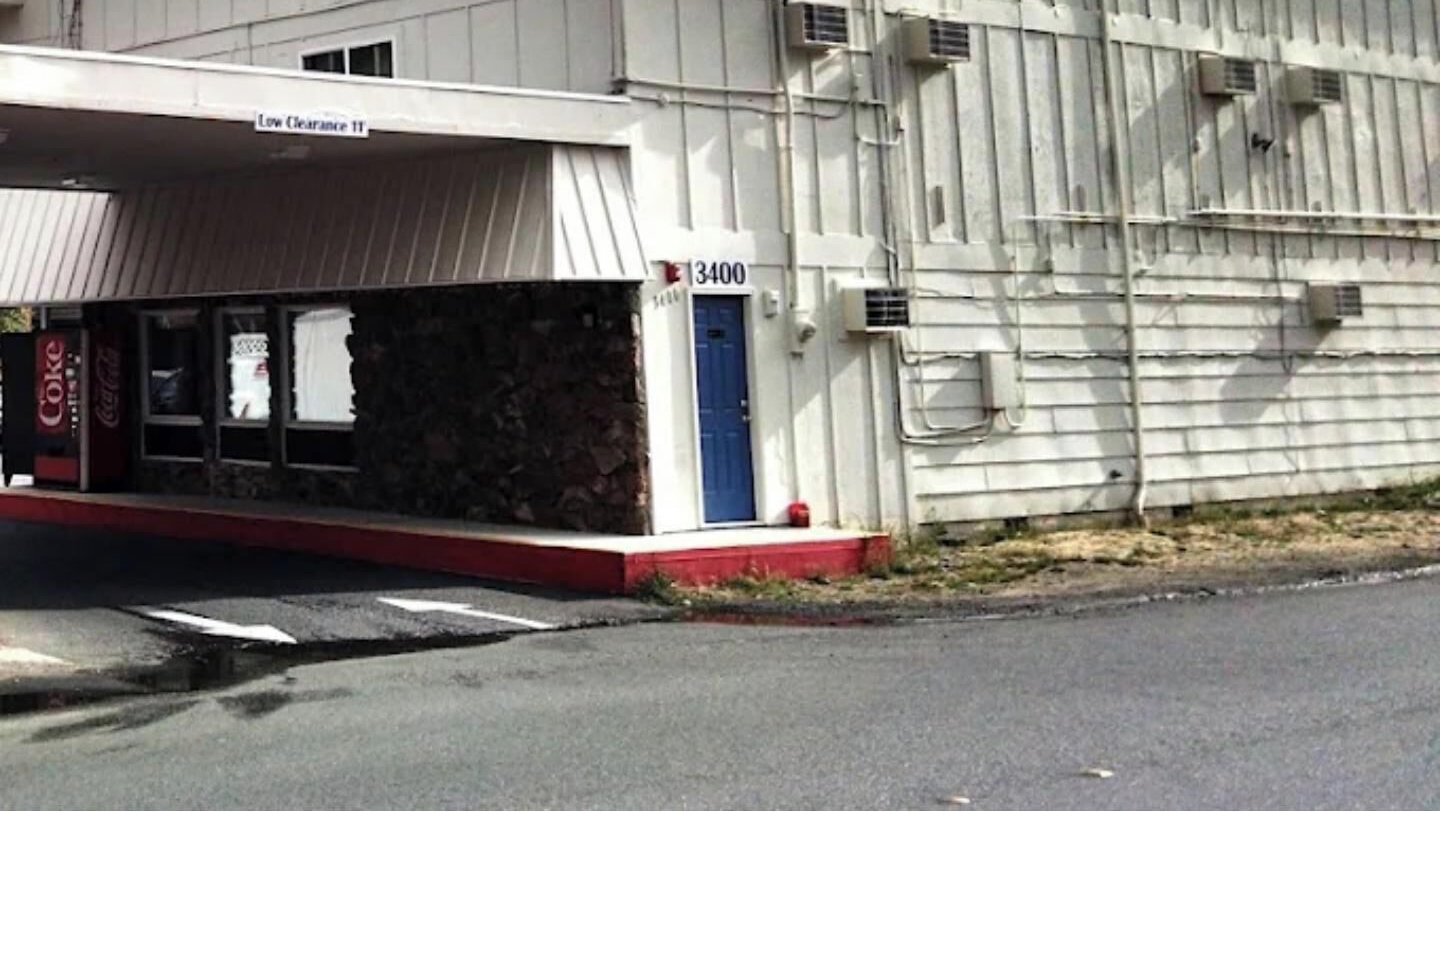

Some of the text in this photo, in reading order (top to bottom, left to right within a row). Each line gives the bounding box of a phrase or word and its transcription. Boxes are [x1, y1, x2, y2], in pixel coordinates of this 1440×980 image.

[258, 114, 282, 128] Low
[286, 116, 348, 132] Clearance
[695, 261, 746, 284] 3400
[39, 339, 64, 427] Coke
